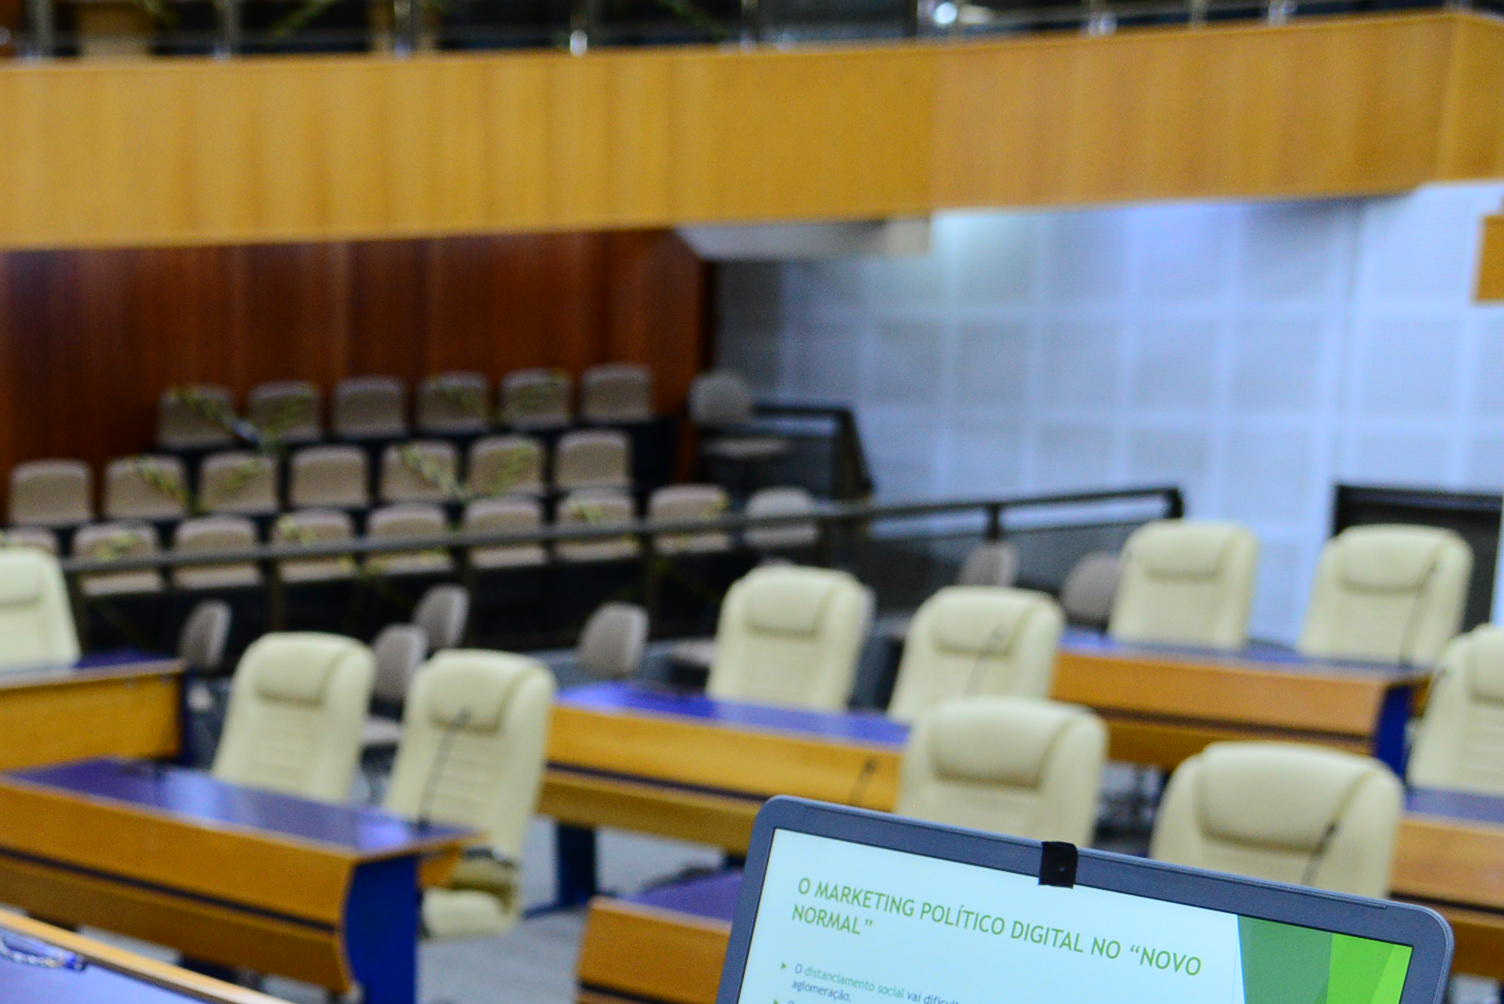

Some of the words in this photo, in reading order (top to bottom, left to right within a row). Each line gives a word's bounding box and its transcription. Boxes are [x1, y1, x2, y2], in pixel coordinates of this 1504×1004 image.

[798, 877, 811, 895] O
[814, 881, 914, 917] MARKETING
[919, 901, 1006, 935] POLÍTICO
[1010, 919, 1083, 953] DIGITAL
[1090, 937, 1121, 959] NO
[794, 962, 803, 974] O
[877, 985, 904, 998] social
[907, 992, 921, 1001] vai
